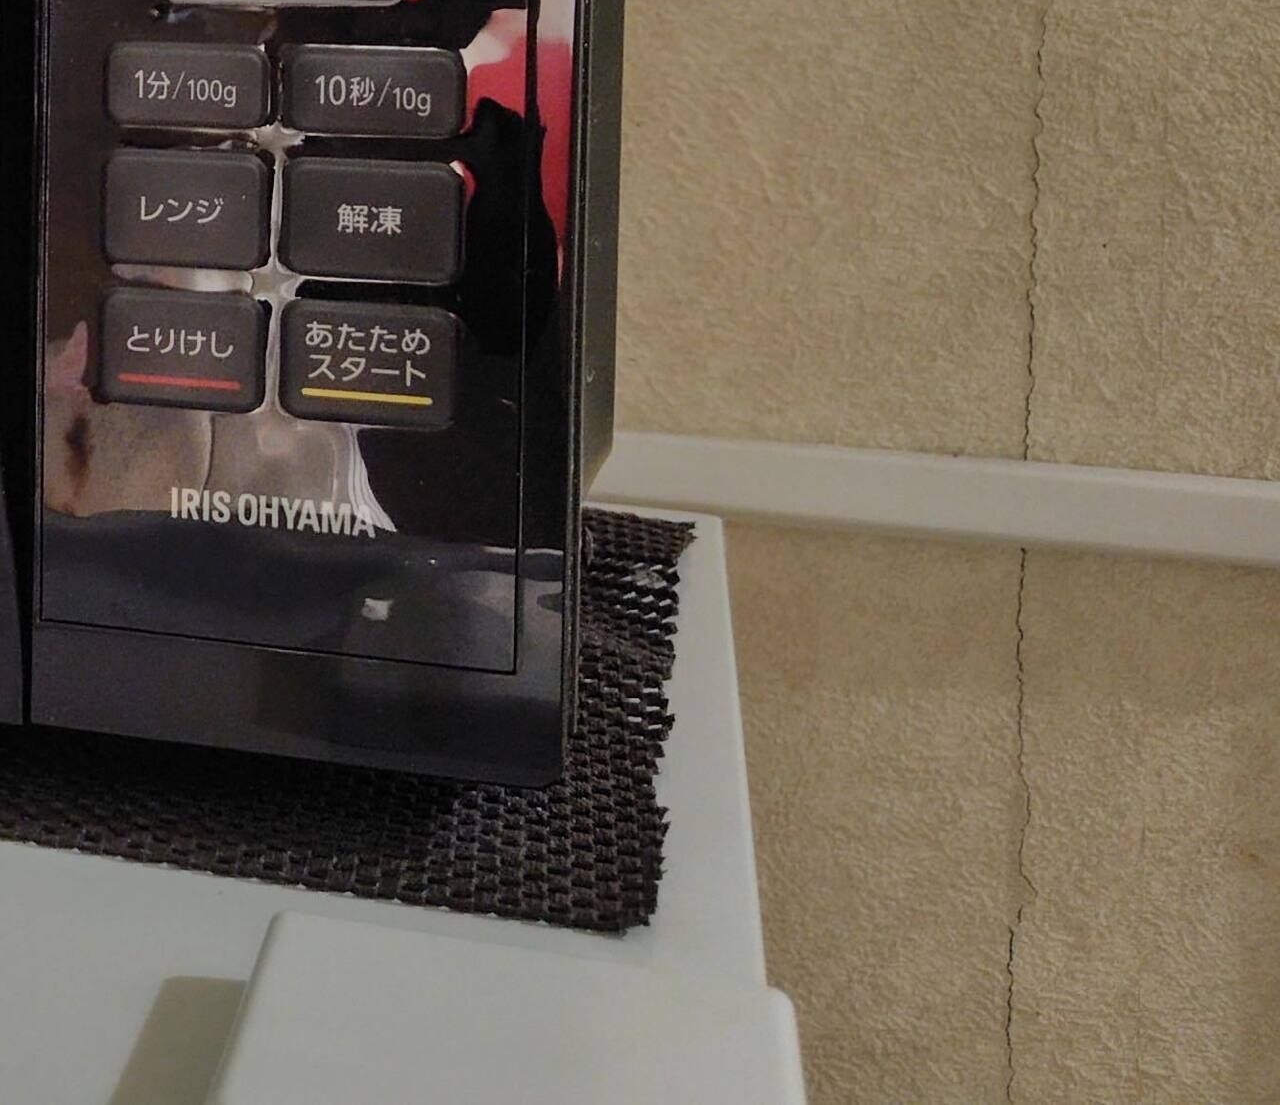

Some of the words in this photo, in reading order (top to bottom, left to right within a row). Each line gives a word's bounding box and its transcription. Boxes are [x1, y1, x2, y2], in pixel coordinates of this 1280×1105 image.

[133, 69, 238, 108] 1分/100g
[314, 74, 432, 116] 10秒/10g
[139, 195, 225, 224] レンジ
[336, 203, 403, 235] 解凍
[126, 325, 235, 359] とりけし
[304, 320, 431, 356] あたため
[307, 354, 427, 387] スタート
[170, 486, 231, 524] IRIS
[238, 492, 376, 539] OHYAMA
